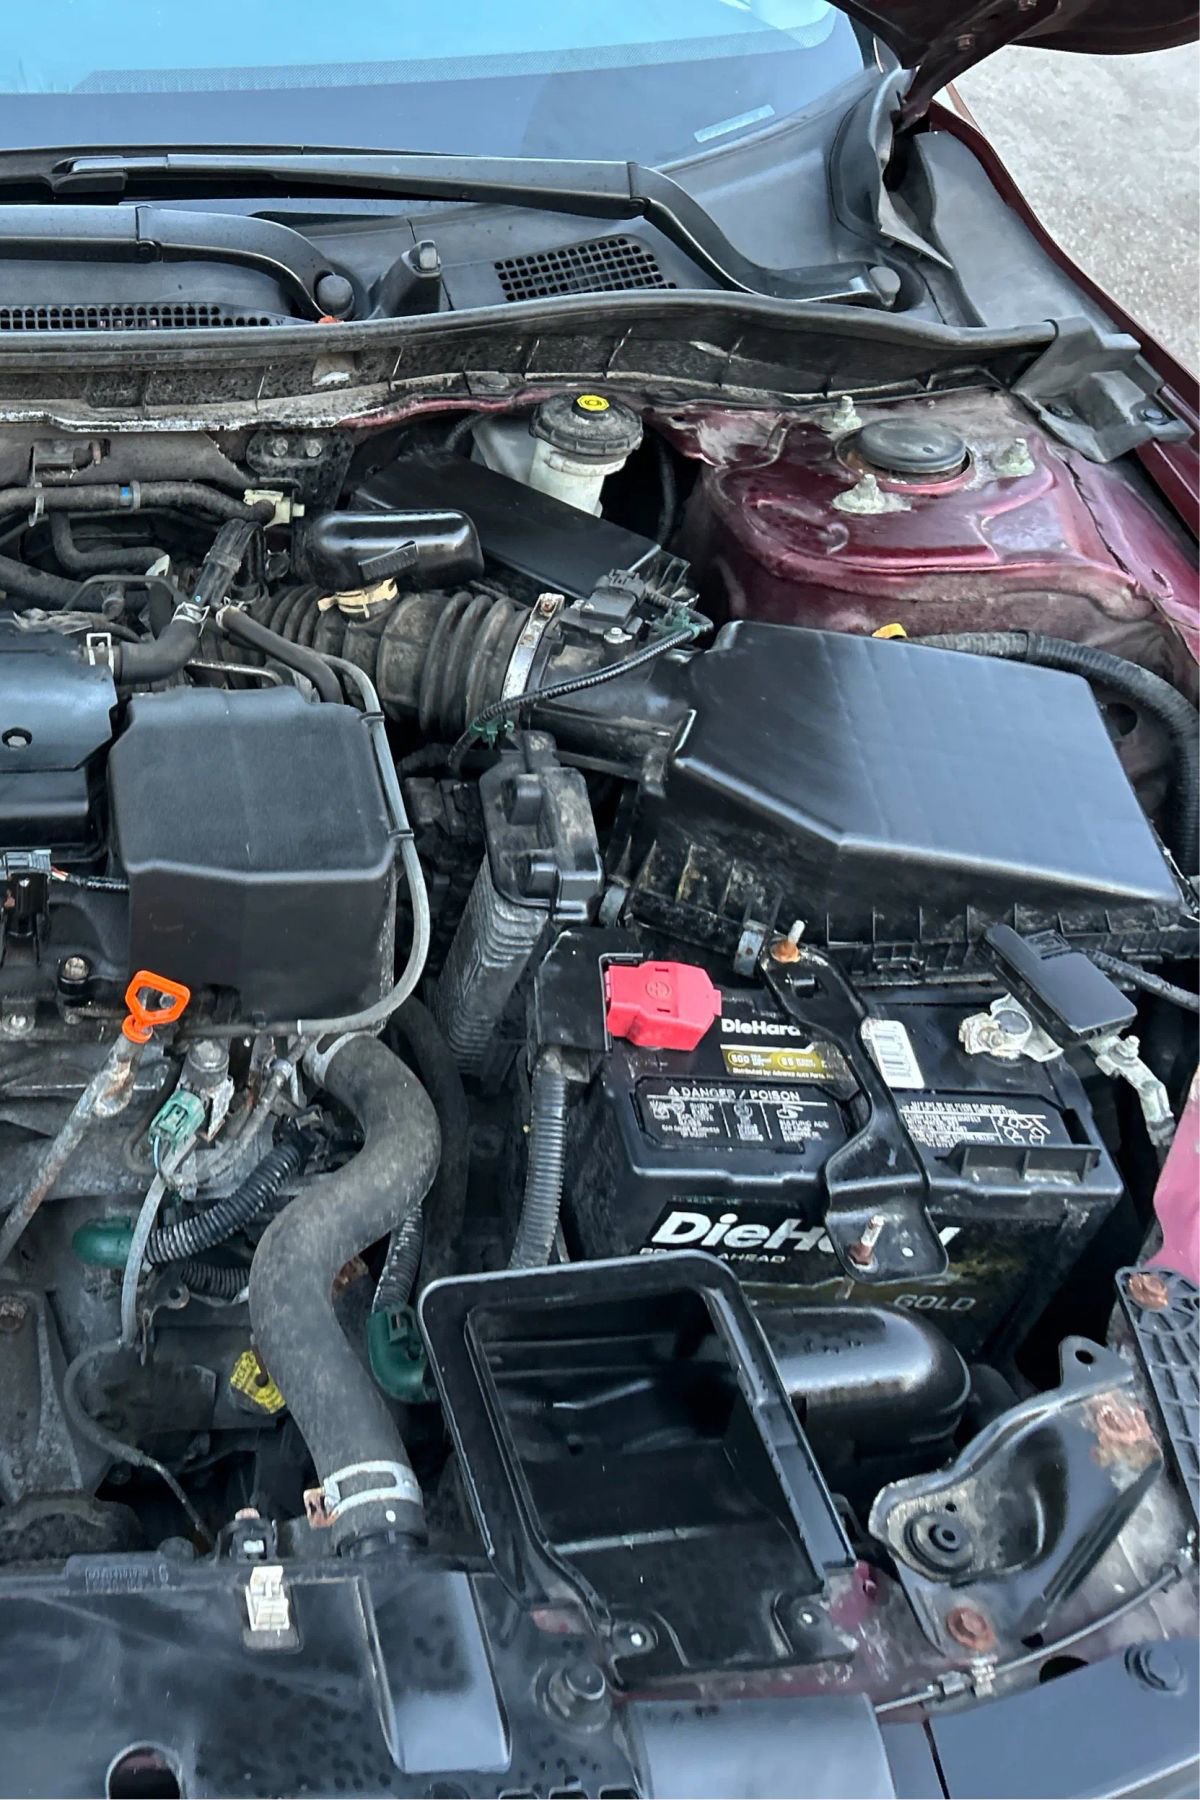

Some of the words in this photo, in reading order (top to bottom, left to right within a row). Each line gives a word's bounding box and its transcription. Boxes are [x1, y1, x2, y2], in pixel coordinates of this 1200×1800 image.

[681, 1087, 736, 1099] DANGER
[750, 1090, 800, 1101] POISON
[894, 1294, 976, 1311] GOLD
